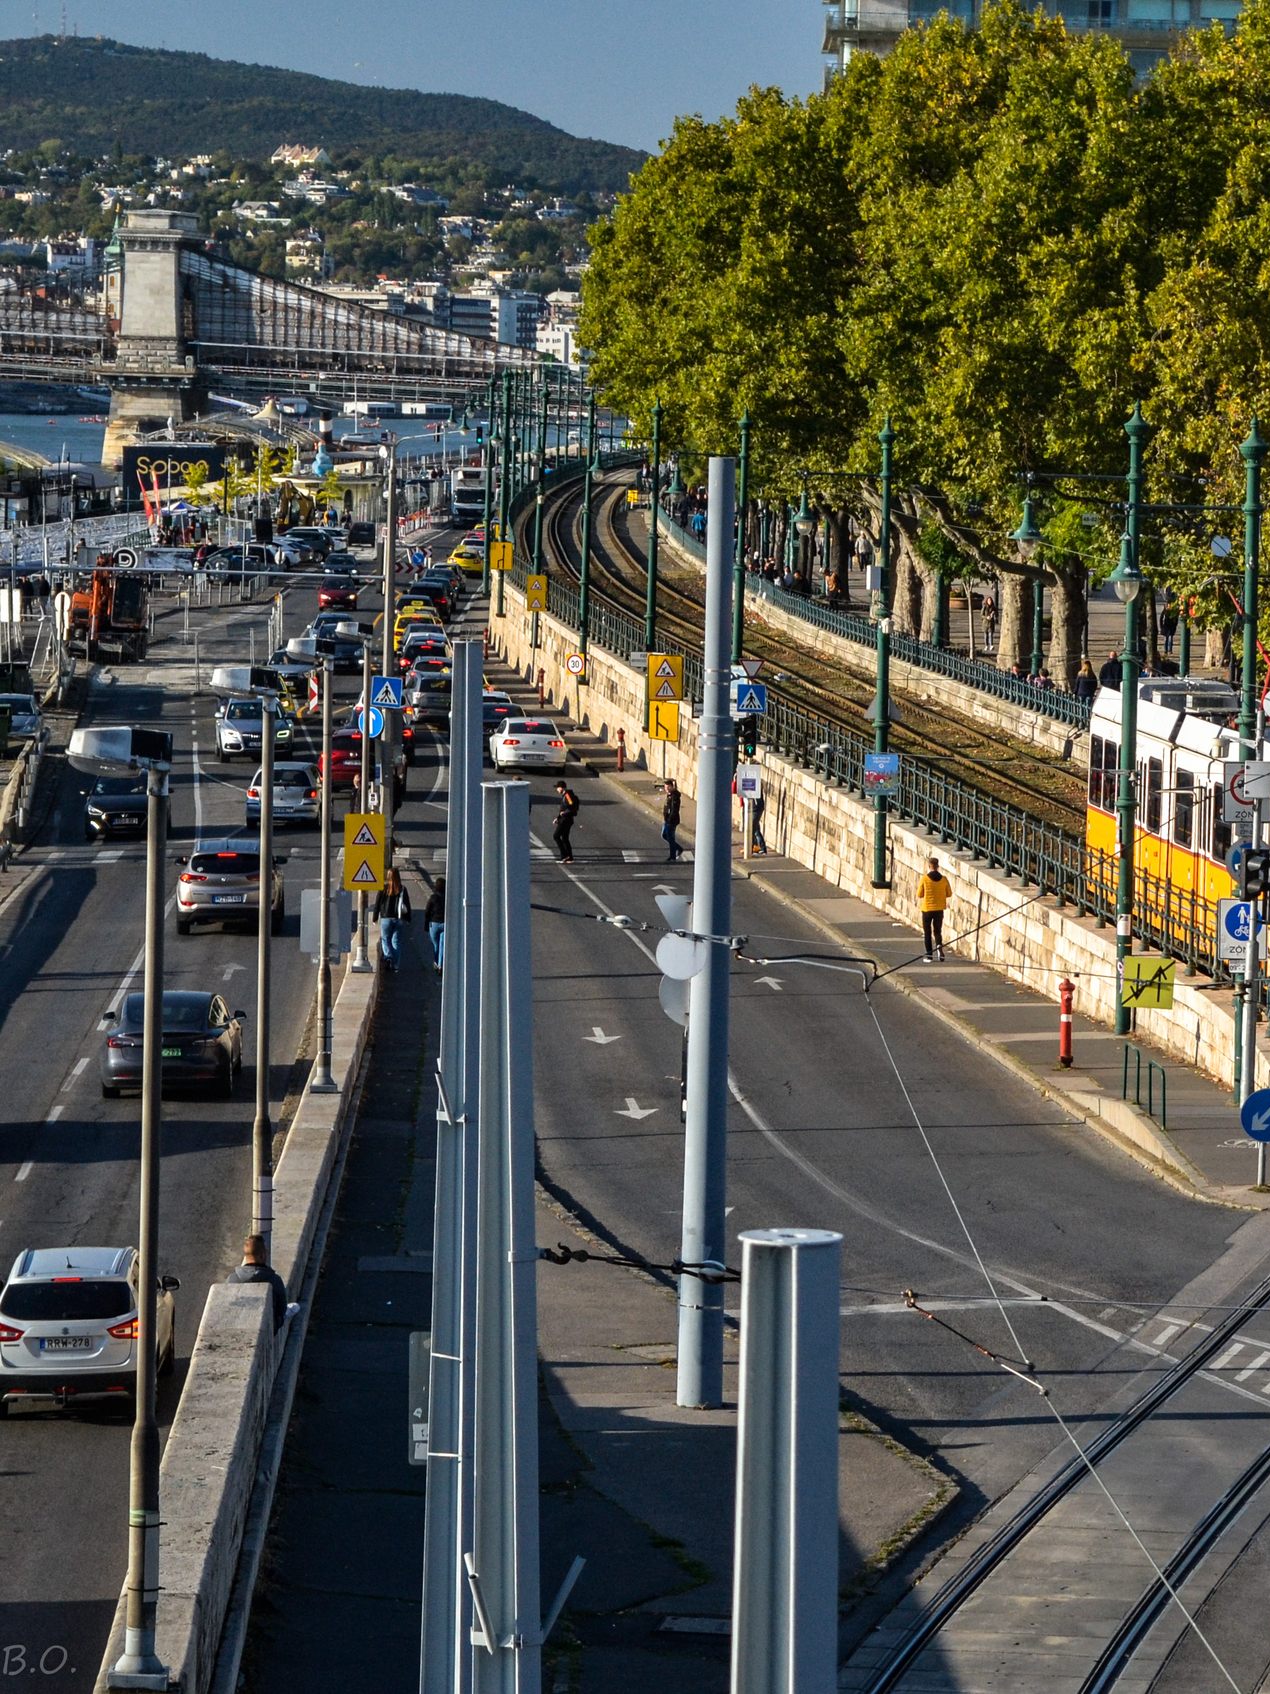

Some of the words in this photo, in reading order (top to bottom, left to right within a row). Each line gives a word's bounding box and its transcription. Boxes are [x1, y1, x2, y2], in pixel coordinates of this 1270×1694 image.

[571, 660, 580, 669] 30
[1235, 811, 1253, 819] ZÓN
[46, 1338, 90, 1349] RRW-278
